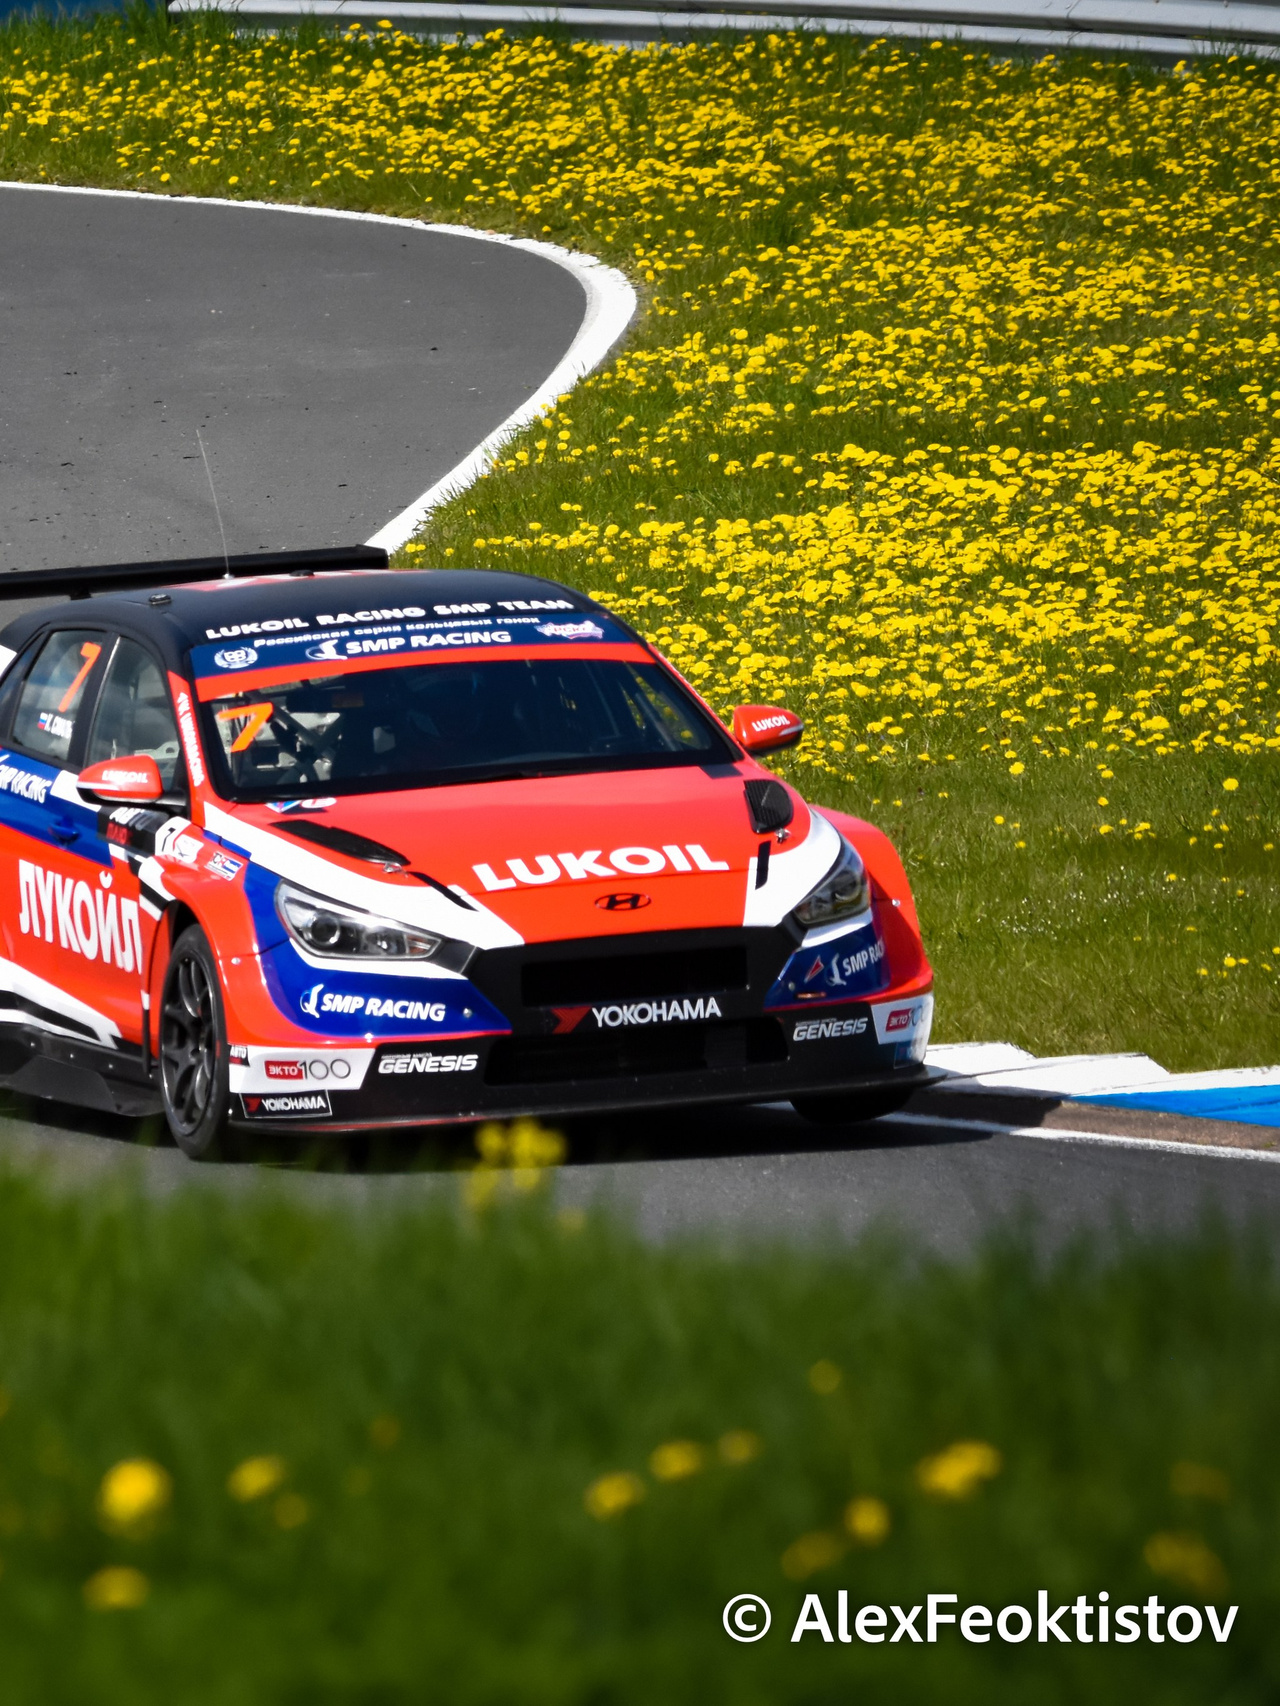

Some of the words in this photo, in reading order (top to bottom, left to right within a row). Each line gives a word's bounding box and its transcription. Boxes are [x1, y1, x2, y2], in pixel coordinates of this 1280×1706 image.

[205, 617, 310, 639] LUKOIL
[315, 607, 426, 625] RACING
[433, 602, 492, 616] SMP
[497, 599, 575, 611] TEAM
[253, 630, 350, 648] Российская
[354, 625, 402, 636] серии
[496, 616, 540, 624] гонок
[345, 637, 406, 654] SMP
[410, 631, 512, 648] RACING
[58, 641, 102, 713] 7
[216, 702, 274, 753] 7
[751, 715, 791, 732] LUKOIL
[12, 769, 53, 804] RACING
[101, 769, 149, 784] LUKOIL
[471, 843, 730, 892] LUKOIL
[18, 858, 143, 975] ЛУКОЙЛ
[842, 949, 869, 977] SMP
[321, 993, 365, 1014] SMP
[365, 998, 446, 1022] RACING
[591, 996, 722, 1028] YOKOHAMA
[792, 1017, 869, 1041] GENESIS
[268, 1064, 298, 1076] ЭКТО
[298, 1058, 351, 1080] 100
[378, 1053, 479, 1074] GENESIS
[261, 1095, 327, 1112] YOKOHAMA
